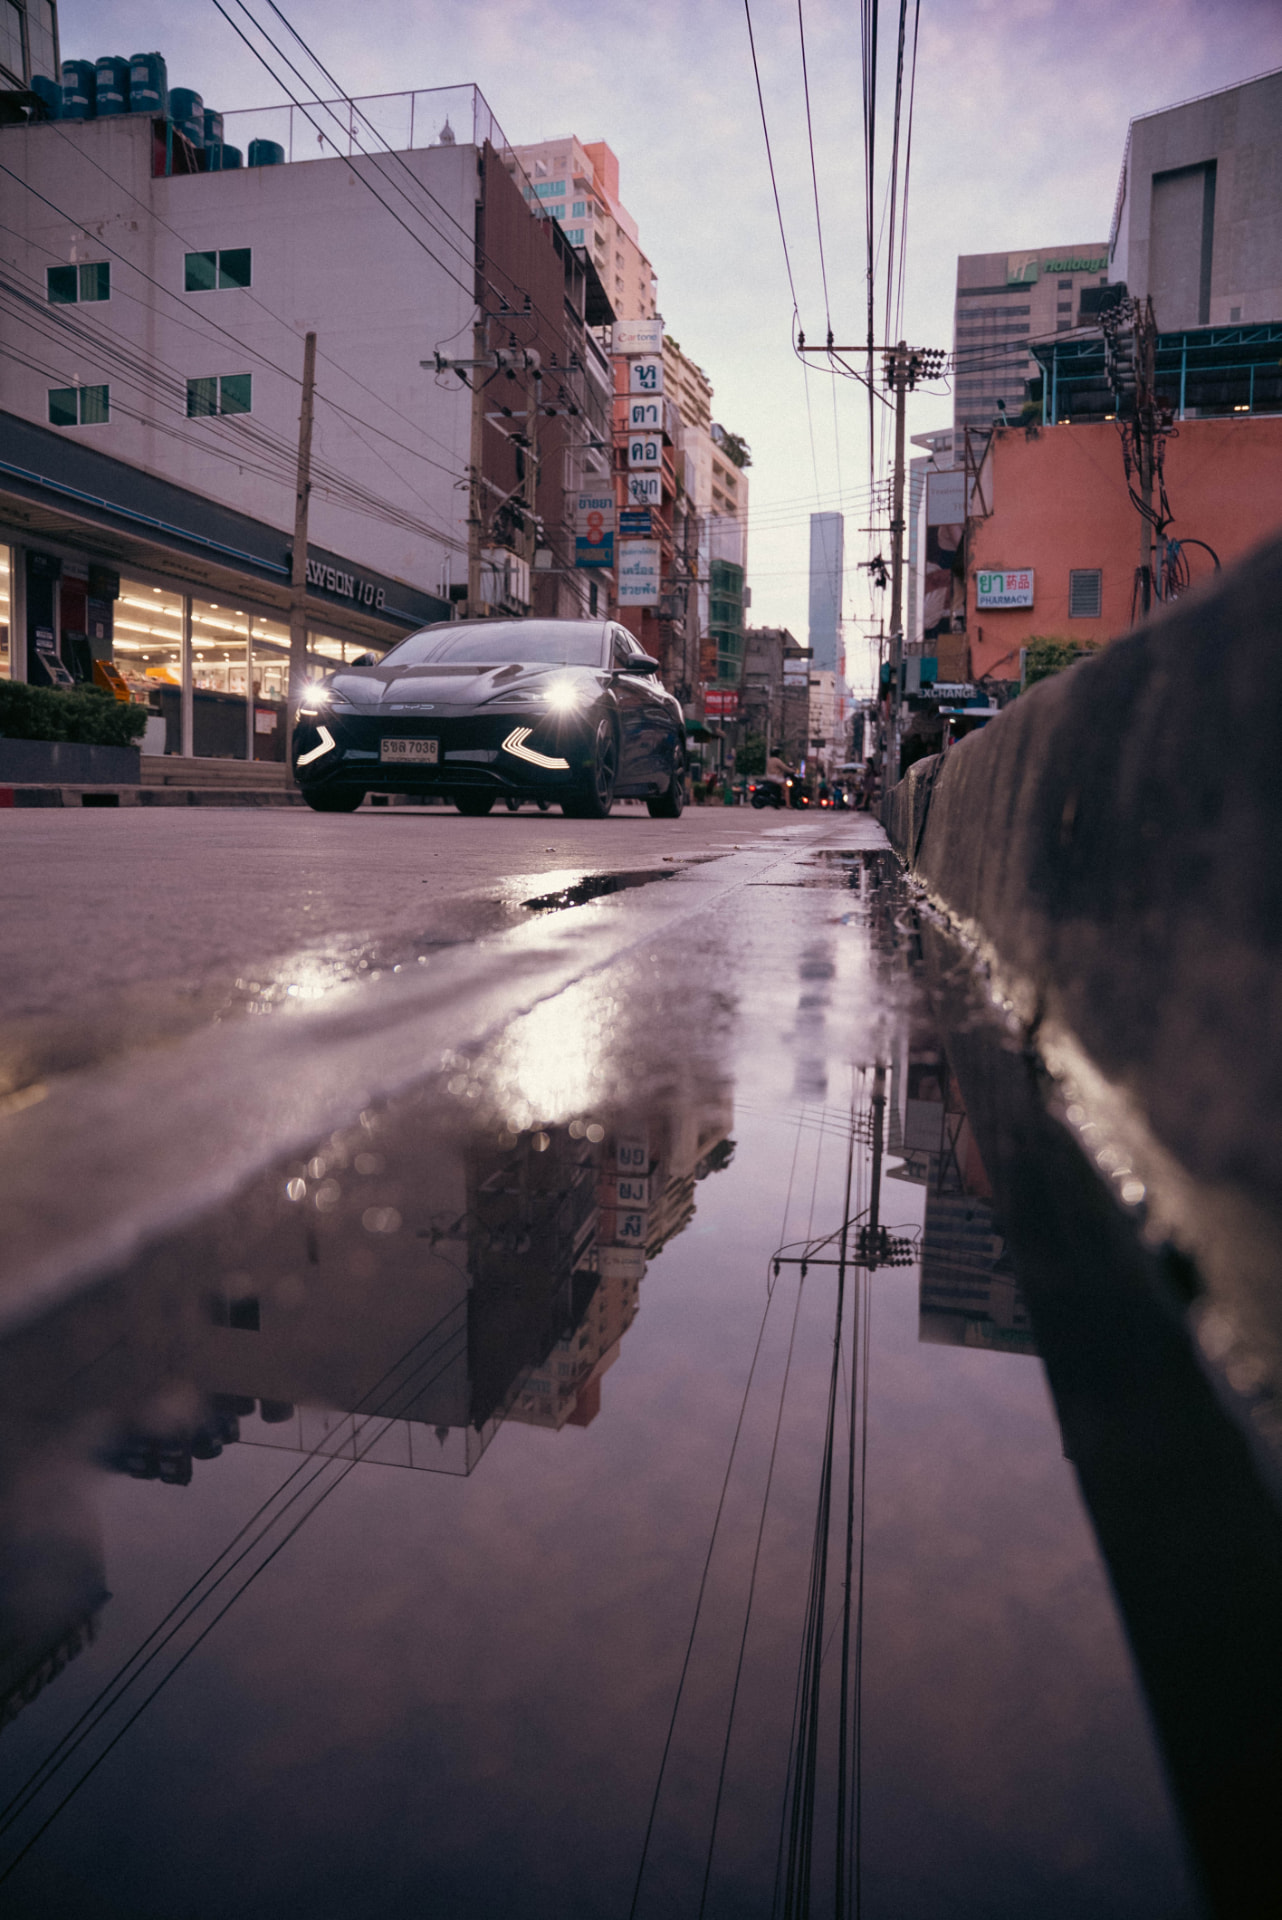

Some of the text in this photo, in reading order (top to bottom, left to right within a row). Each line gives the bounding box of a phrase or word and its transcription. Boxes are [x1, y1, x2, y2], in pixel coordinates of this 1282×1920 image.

[1045, 257, 1101, 272] Holiday
[634, 365, 656, 389] หู
[632, 405, 657, 423] ตา
[631, 442, 657, 460] คอ
[630, 479, 658, 503] จมูก
[306, 559, 386, 609] AWSON 108
[979, 574, 1003, 594] ยา
[980, 595, 1028, 605] PHARMACY
[918, 688, 977, 698] EXCHANGE
[408, 741, 436, 754] 7036
